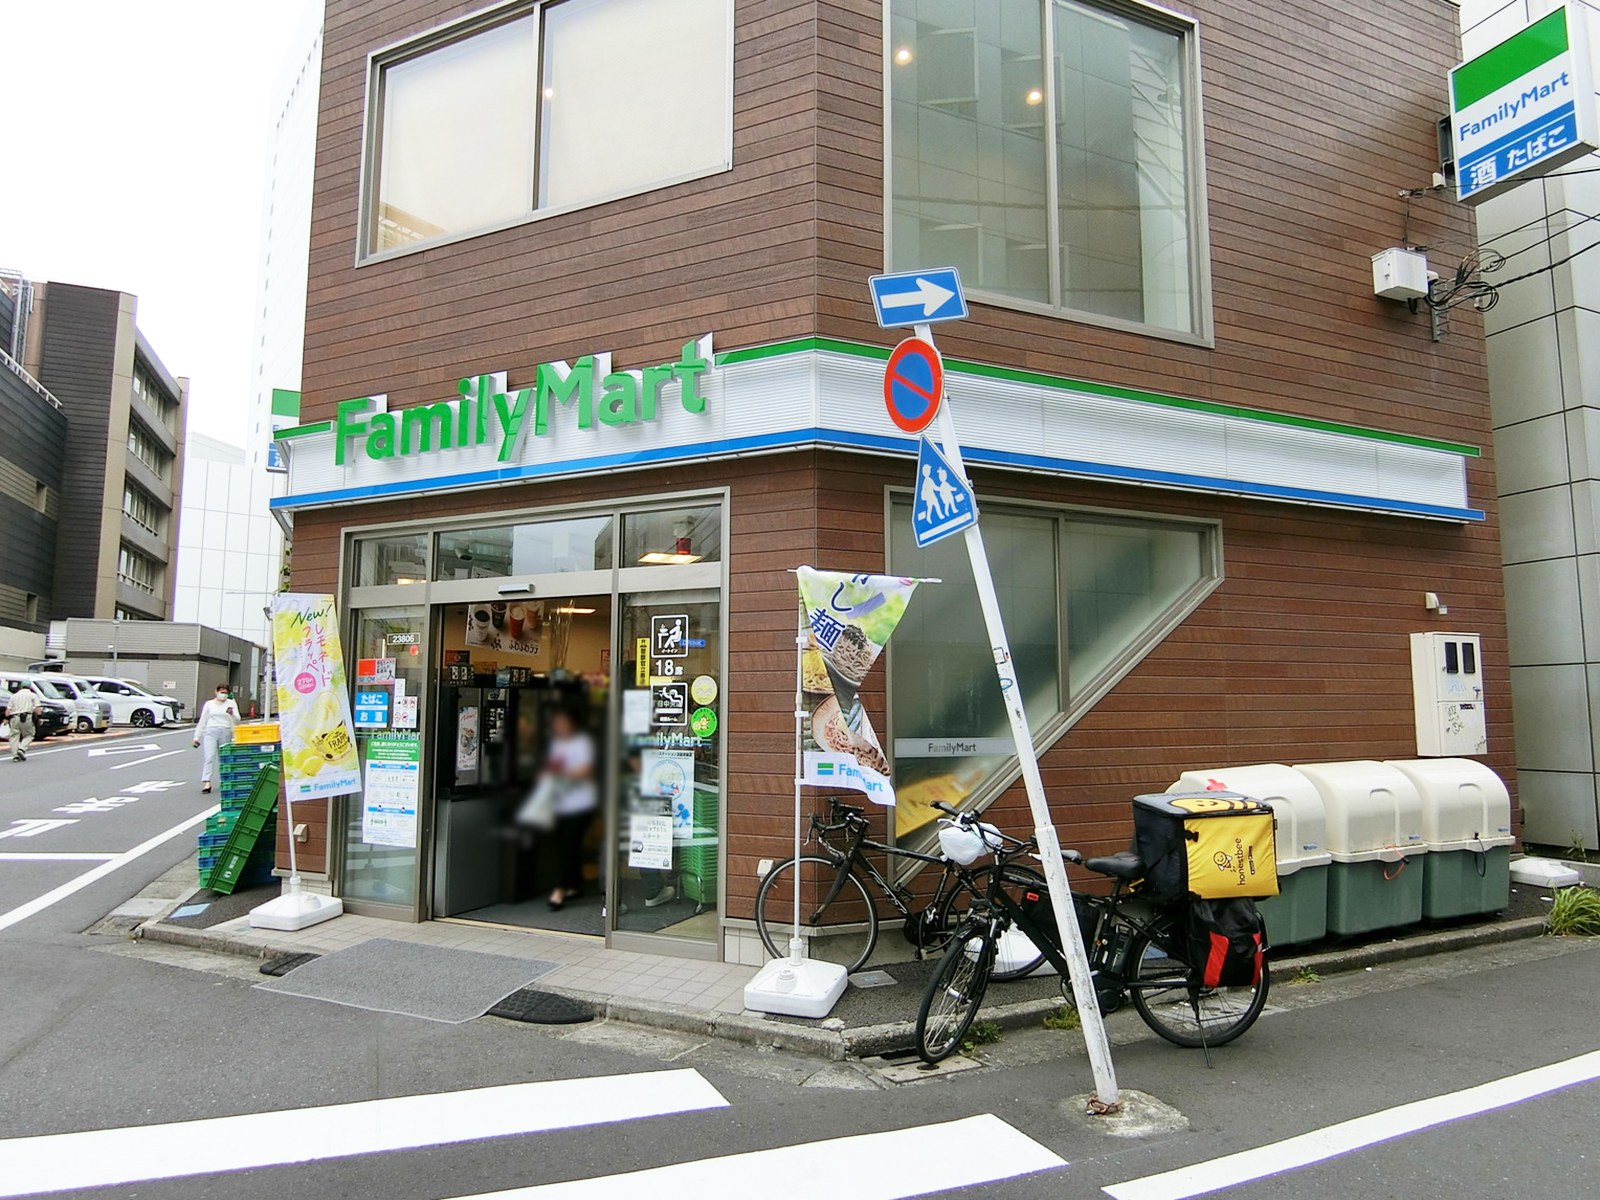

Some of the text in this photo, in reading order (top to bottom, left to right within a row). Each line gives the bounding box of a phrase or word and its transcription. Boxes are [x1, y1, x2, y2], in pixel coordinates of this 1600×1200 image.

[1460, 71, 1570, 142] FamilyMart
[1470, 124, 1568, 190] 酒 たばこ
[335, 335, 710, 466] FamilyMart
[290, 603, 333, 629] New!
[302, 626, 319, 672] フラッペ
[392, 634, 415, 643] 23806
[315, 624, 333, 687] レモネード
[361, 694, 383, 705] たばこ
[629, 732, 702, 750] ilyMart
[928, 743, 977, 754] FamilyMart
[313, 778, 357, 791] FamilyMart
[838, 763, 884, 792] Famart
[1234, 838, 1246, 886] honestbee
